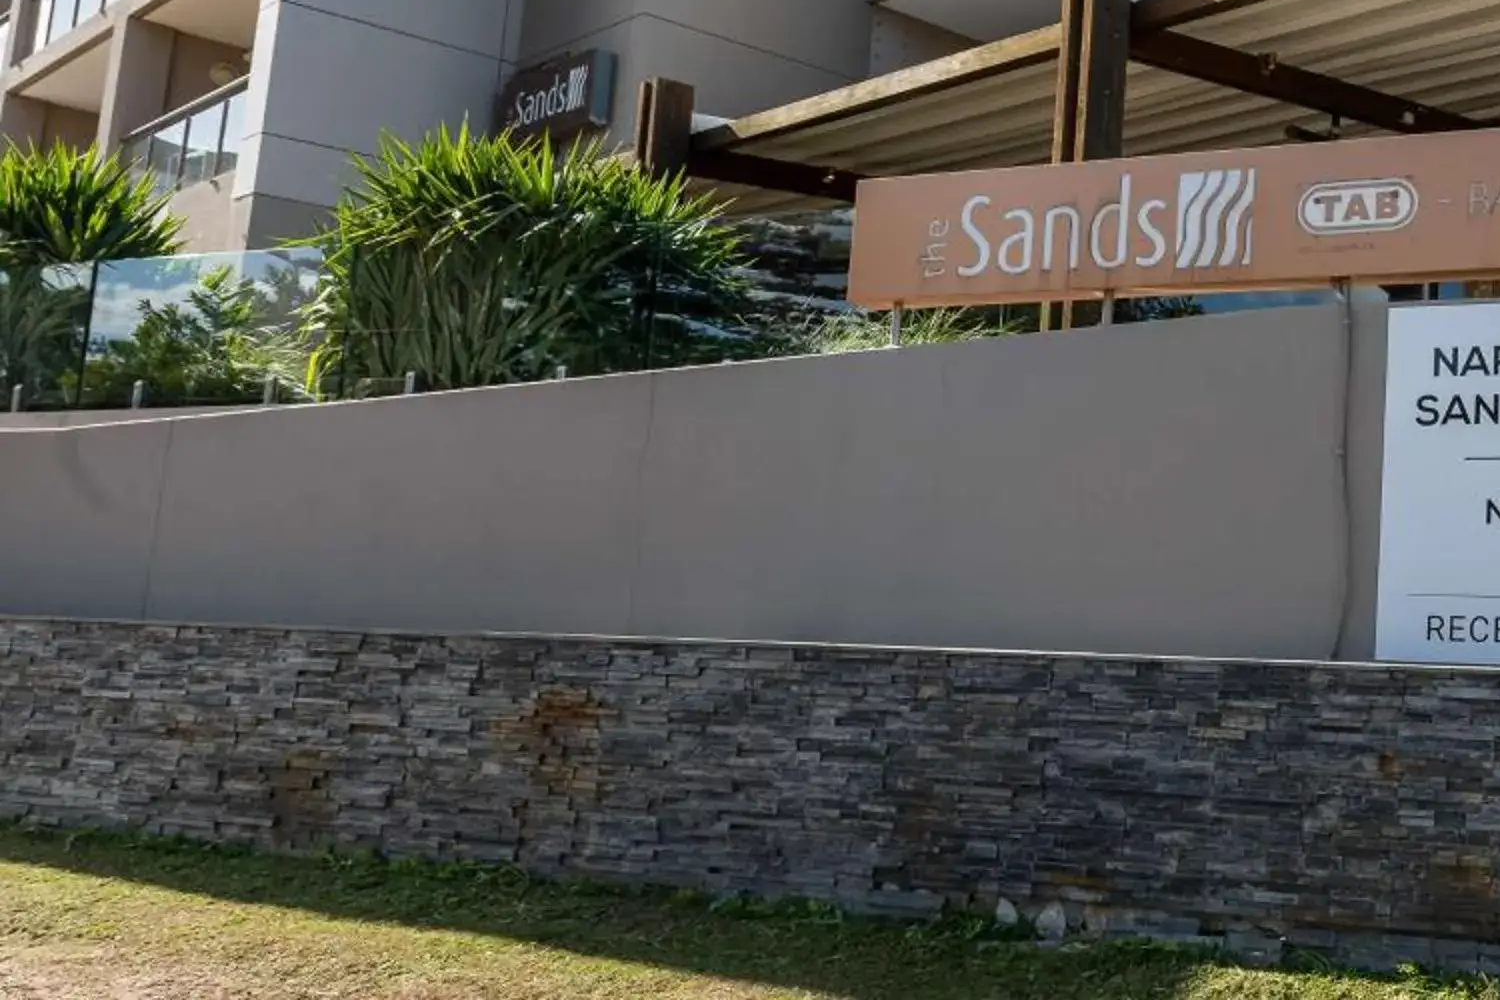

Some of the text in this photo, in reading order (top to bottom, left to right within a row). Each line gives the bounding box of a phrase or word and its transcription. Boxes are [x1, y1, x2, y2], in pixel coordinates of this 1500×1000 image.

[515, 73, 567, 128] Sands
[921, 172, 1166, 278] the Sands
[1317, 190, 1399, 223] TAB
